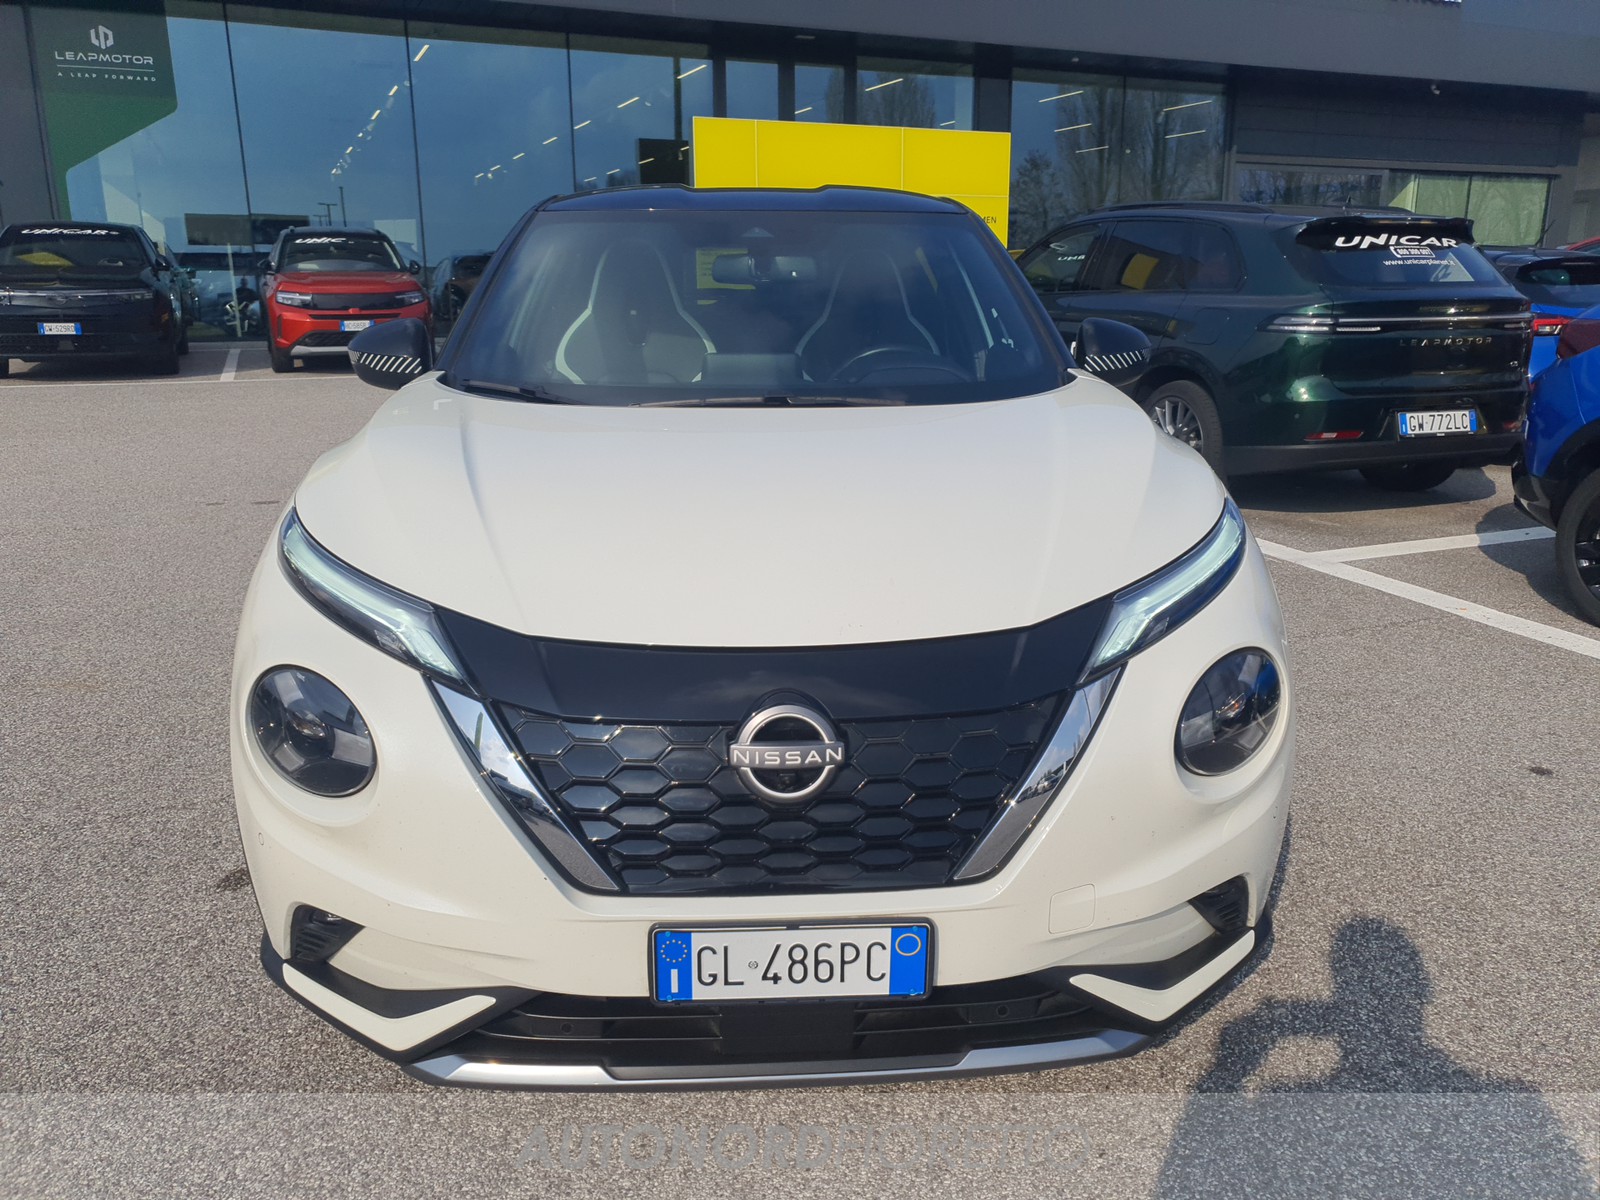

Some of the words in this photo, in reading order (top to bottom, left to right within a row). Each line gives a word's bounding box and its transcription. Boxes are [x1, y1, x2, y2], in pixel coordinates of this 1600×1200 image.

[54, 51, 154, 65] LEAPMOTOR
[1335, 233, 1458, 249] UNICAR
[1400, 337, 1492, 346] LEAPMOTOR
[1408, 415, 1424, 431] GW
[1428, 413, 1468, 430] 772LC
[733, 747, 842, 764] NISSAN
[697, 945, 744, 986] GL
[761, 941, 887, 985] 486PC
